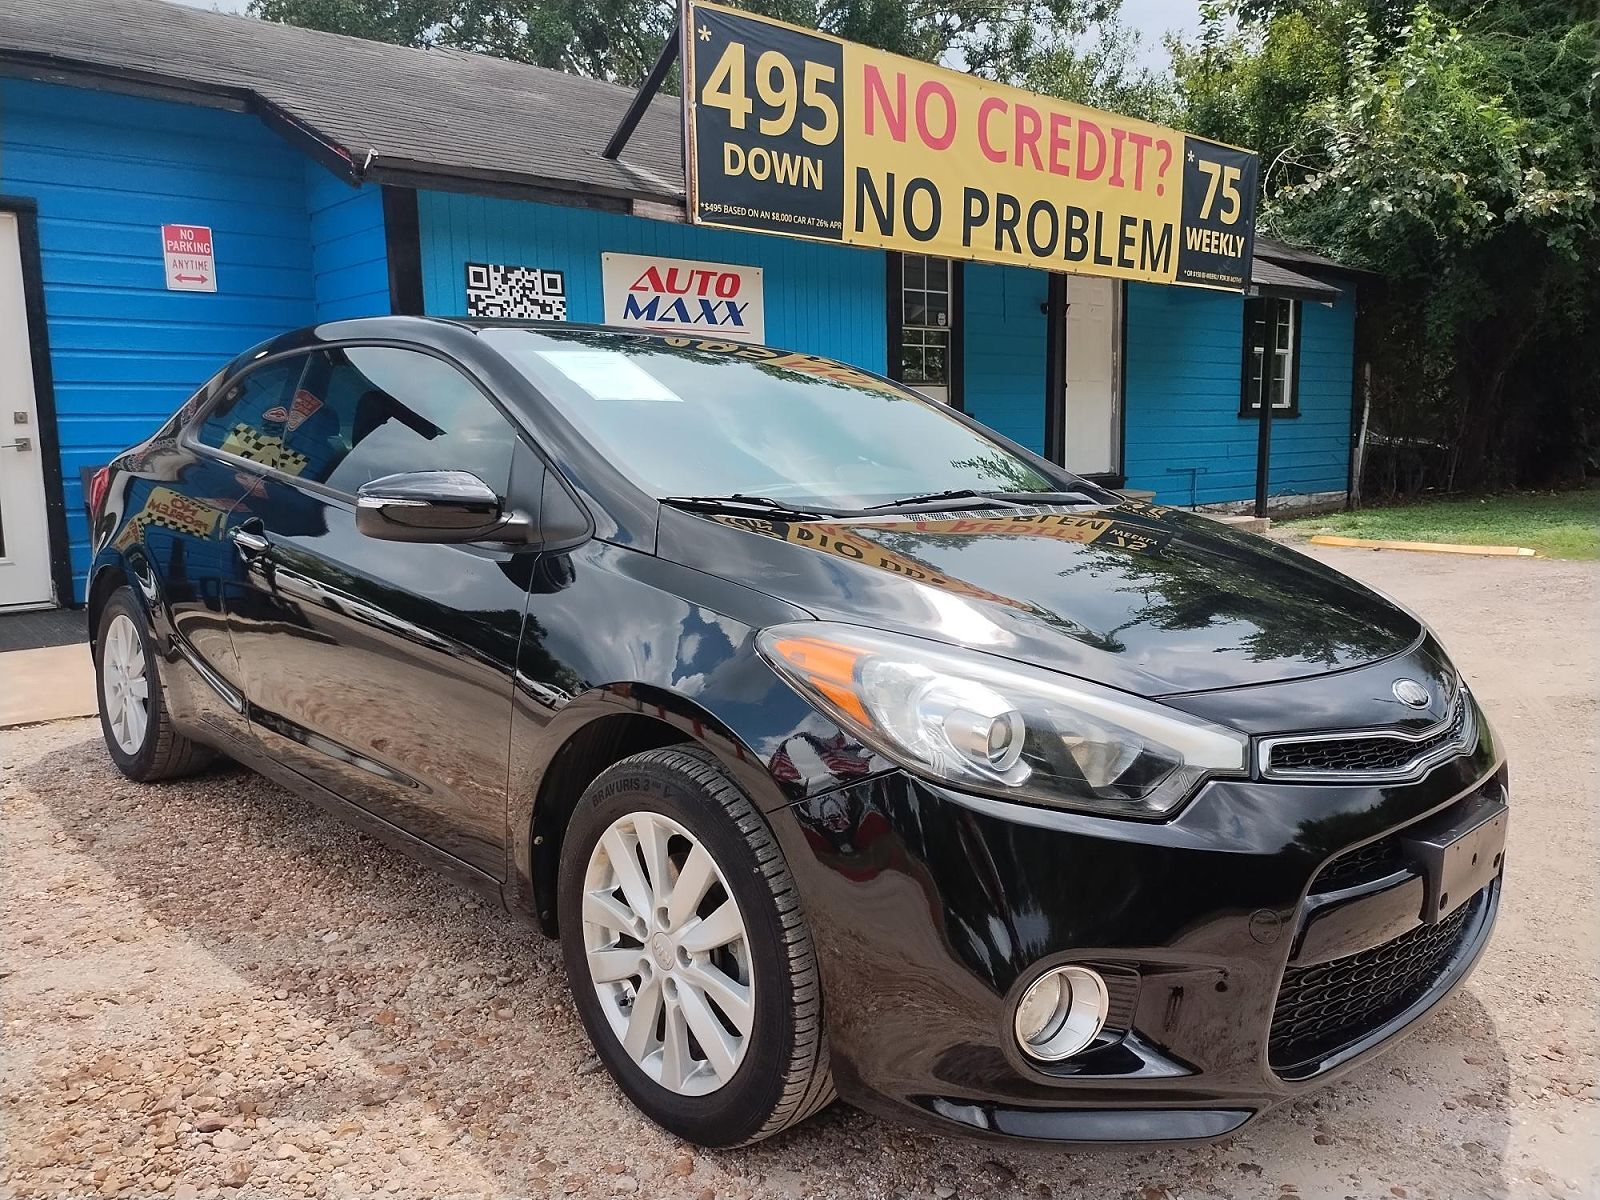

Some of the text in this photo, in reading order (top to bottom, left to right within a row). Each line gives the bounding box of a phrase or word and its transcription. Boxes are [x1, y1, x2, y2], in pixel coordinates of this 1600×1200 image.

[863, 63, 1173, 197] NO CREDIT?
[723, 142, 823, 191] DOWN
[723, 204, 747, 216] BASED
[747, 208, 759, 218] ON
[760, 209, 771, 220] AN
[771, 212, 793, 223] $8,000
[793, 215, 807, 225] CAR
[807, 217, 816, 226] AT
[816, 218, 829, 228] 26%
[829, 220, 842, 230] APR
[855, 166, 1174, 274] NO PROBLEM
[166, 240, 211, 254] PARKING
[180, 229, 195, 241] NO
[1185, 226, 1245, 258] WEEKLY
[172, 258, 209, 272] ANYTIME
[628, 266, 741, 298] AUTO
[623, 293, 750, 327] MAXX
[591, 778, 640, 808] BRAVURIS
